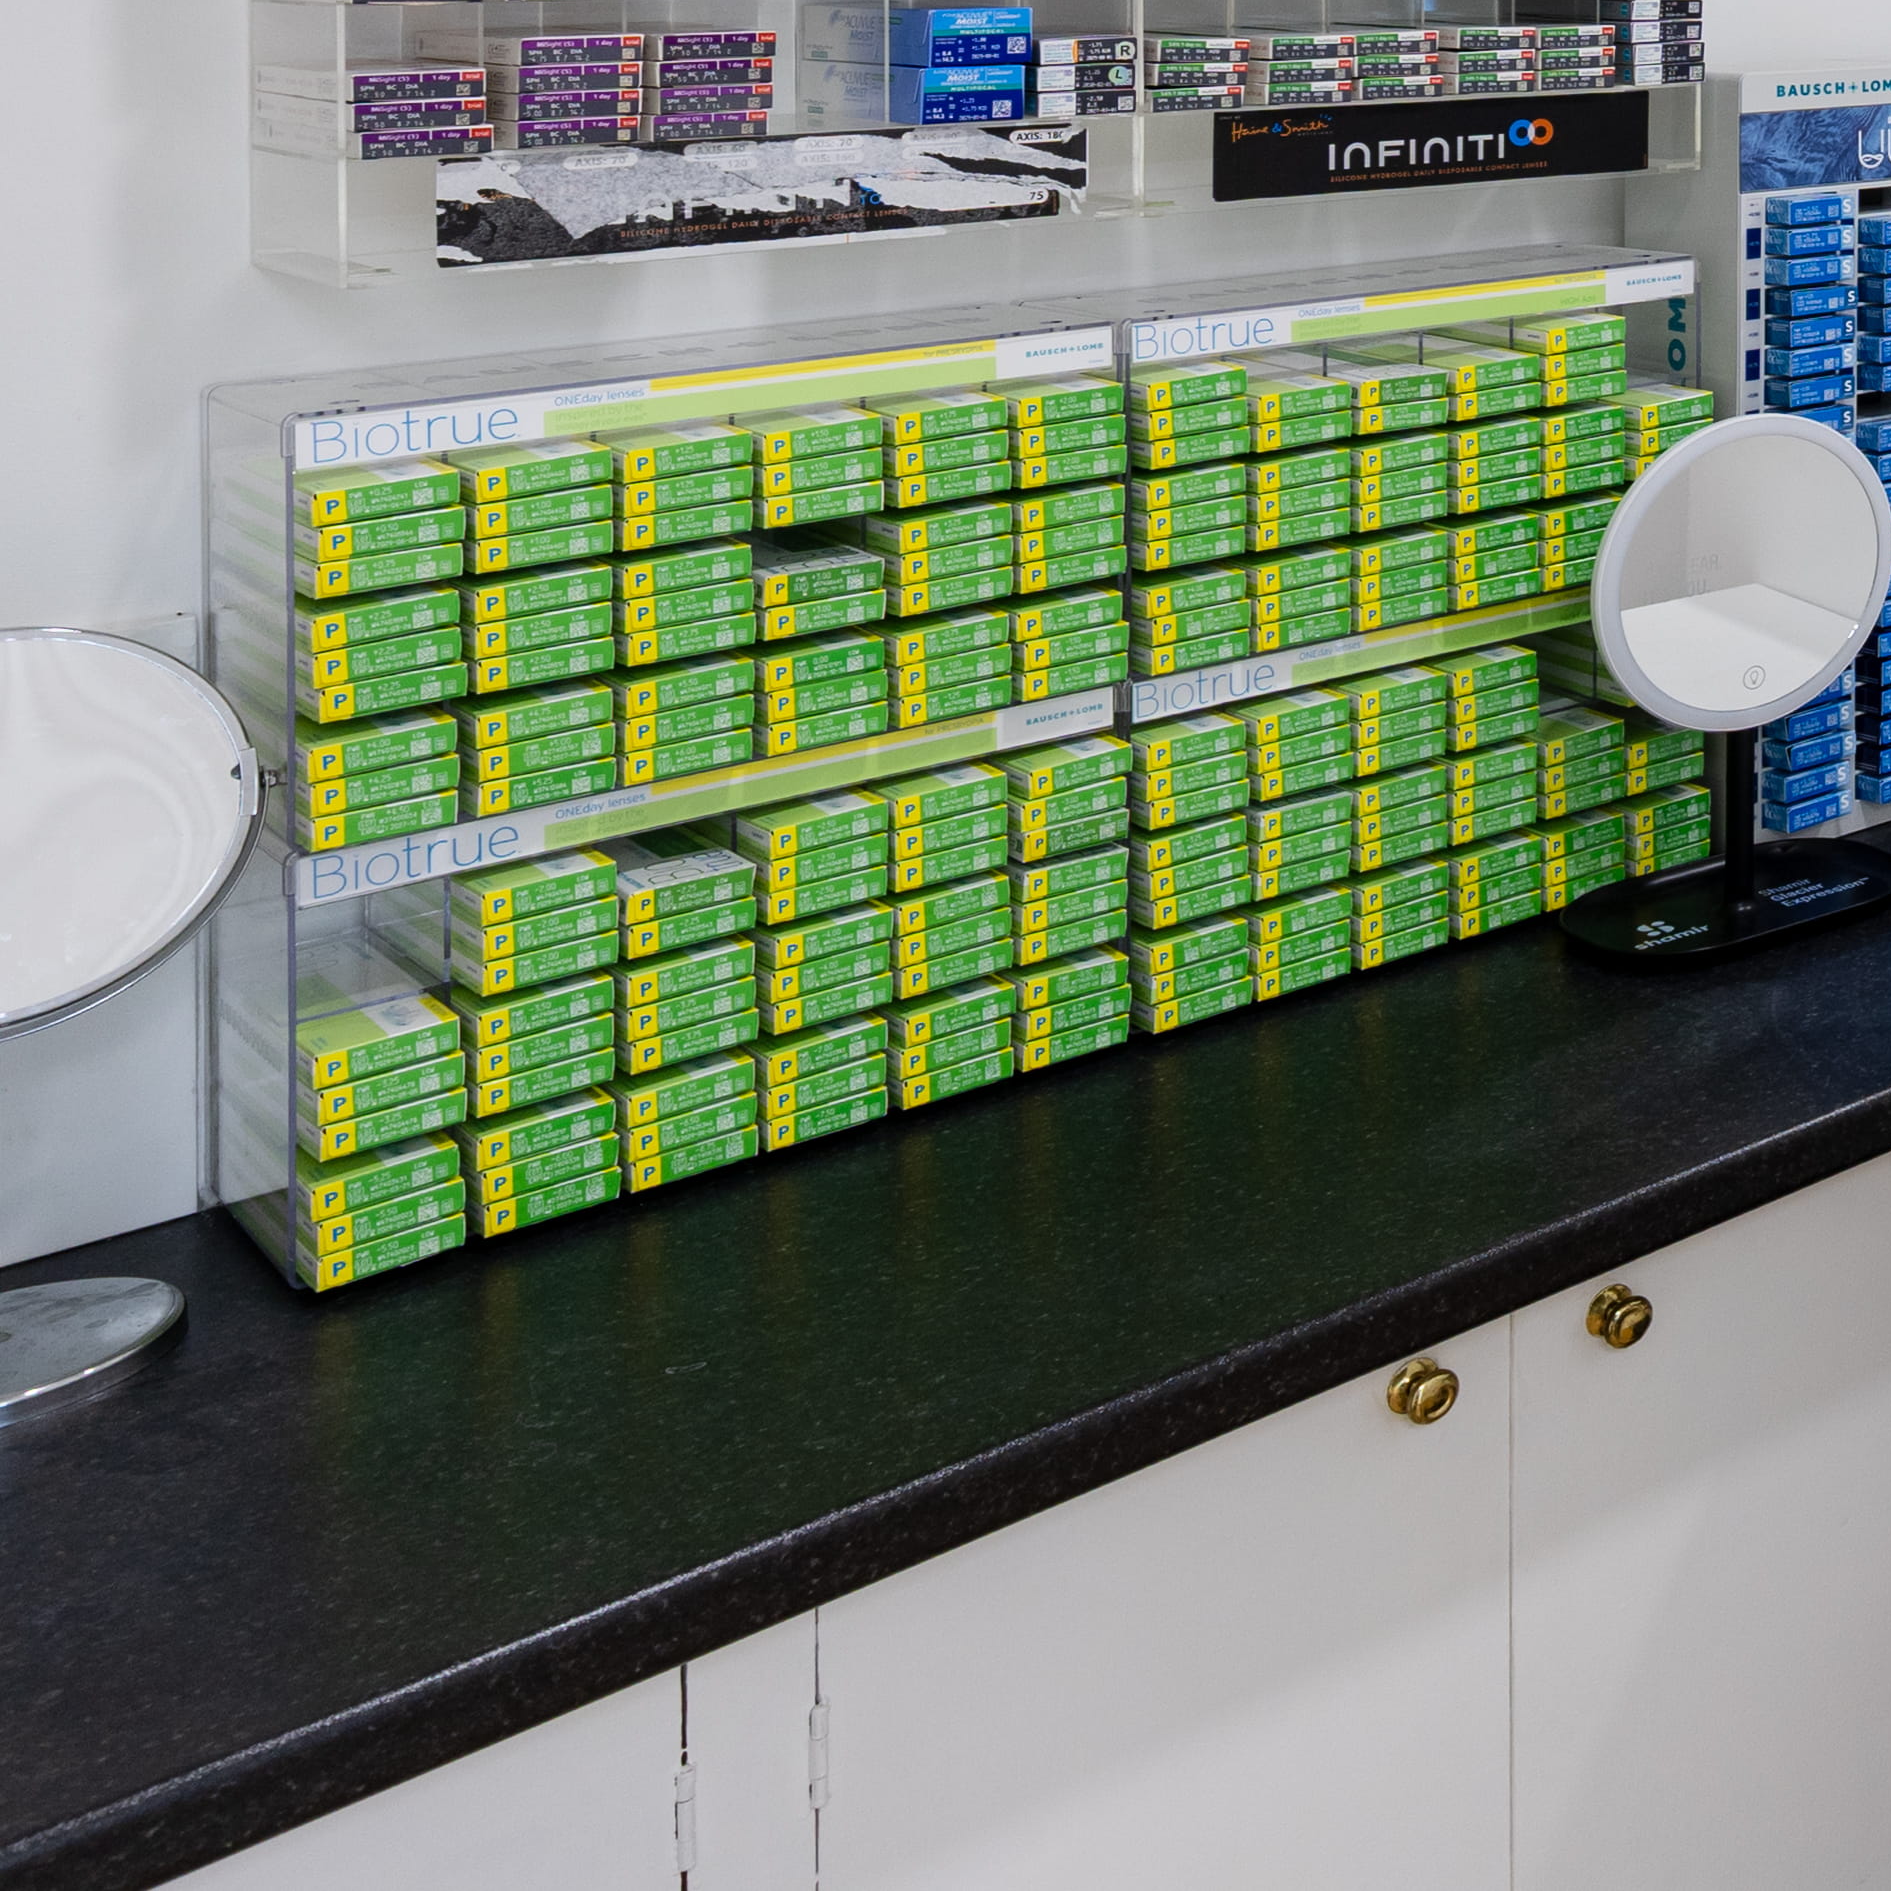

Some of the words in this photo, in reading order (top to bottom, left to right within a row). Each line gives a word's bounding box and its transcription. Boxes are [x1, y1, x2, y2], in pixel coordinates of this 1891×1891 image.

[1119, 45, 1131, 56] R
[947, 74, 980, 82] MOIST
[1115, 70, 1123, 80] L
[1016, 131, 1042, 140] AXIS:
[1272, 123, 1282, 133] &
[1330, 174, 1367, 182] SILICONE
[1414, 169, 1435, 177] DAILY
[1485, 163, 1519, 171] CONTACT
[1522, 161, 1548, 169] LENSES
[1029, 191, 1044, 200] 75
[1843, 199, 1851, 212] S
[620, 228, 669, 238] SILICONE
[1848, 290, 1855, 302] S
[1298, 306, 1332, 318] ONEday
[1134, 317, 1274, 360] Biotrue
[554, 392, 603, 408] ONEday
[607, 388, 644, 398] lenses
[310, 408, 518, 463] Biotrue
[637, 457, 648, 471] P
[488, 476, 501, 491] P
[326, 499, 340, 514] P
[1300, 647, 1332, 661] ONEday
[1135, 664, 1274, 719] Biotrue
[322, 755, 336, 770] P
[491, 790, 503, 805] P
[555, 800, 604, 819] ONEday
[608, 792, 647, 807] lenses
[311, 825, 519, 899] Biotrue
[1758, 877, 1810, 897] Shamir
[1770, 883, 1824, 902] Glacier
[1634, 923, 1709, 950] shamir
[328, 1061, 341, 1077] P
